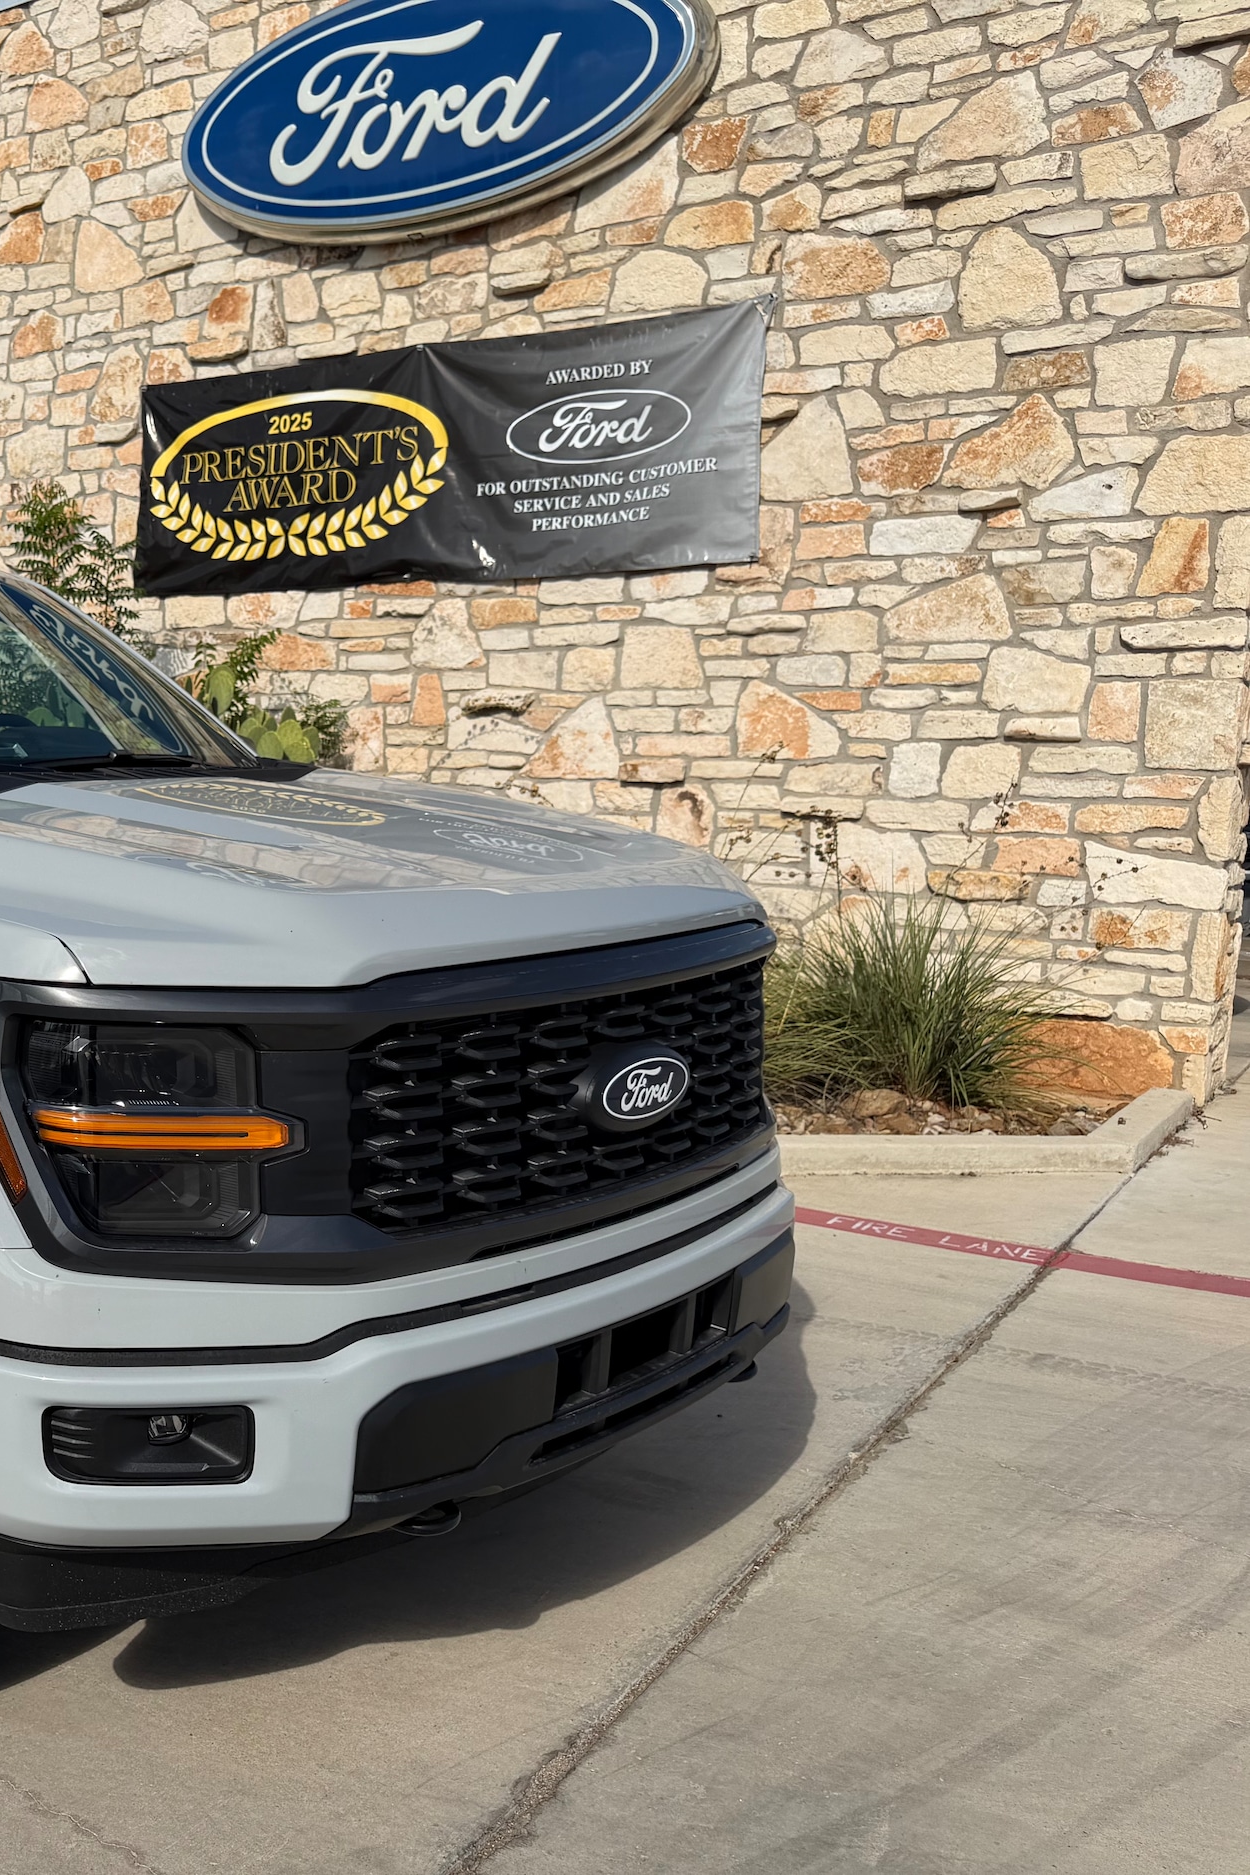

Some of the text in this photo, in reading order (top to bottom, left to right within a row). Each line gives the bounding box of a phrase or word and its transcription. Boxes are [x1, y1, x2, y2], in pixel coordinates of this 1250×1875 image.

[268, 20, 562, 187] Ford
[545, 359, 653, 386] AWARDED BY
[268, 412, 312, 435] 2025
[538, 399, 653, 453] Ford
[180, 426, 420, 484] PRESIDENT'S
[476, 457, 717, 497] FOR OUTSTANDING CUSTOMER
[223, 469, 357, 513] AWARD
[513, 483, 670, 513] SERVICE AND SALES
[531, 506, 650, 531] PERFORMANCE
[620, 1066, 674, 1112] Ford
[826, 1215, 1045, 1262] FIRE LANE
